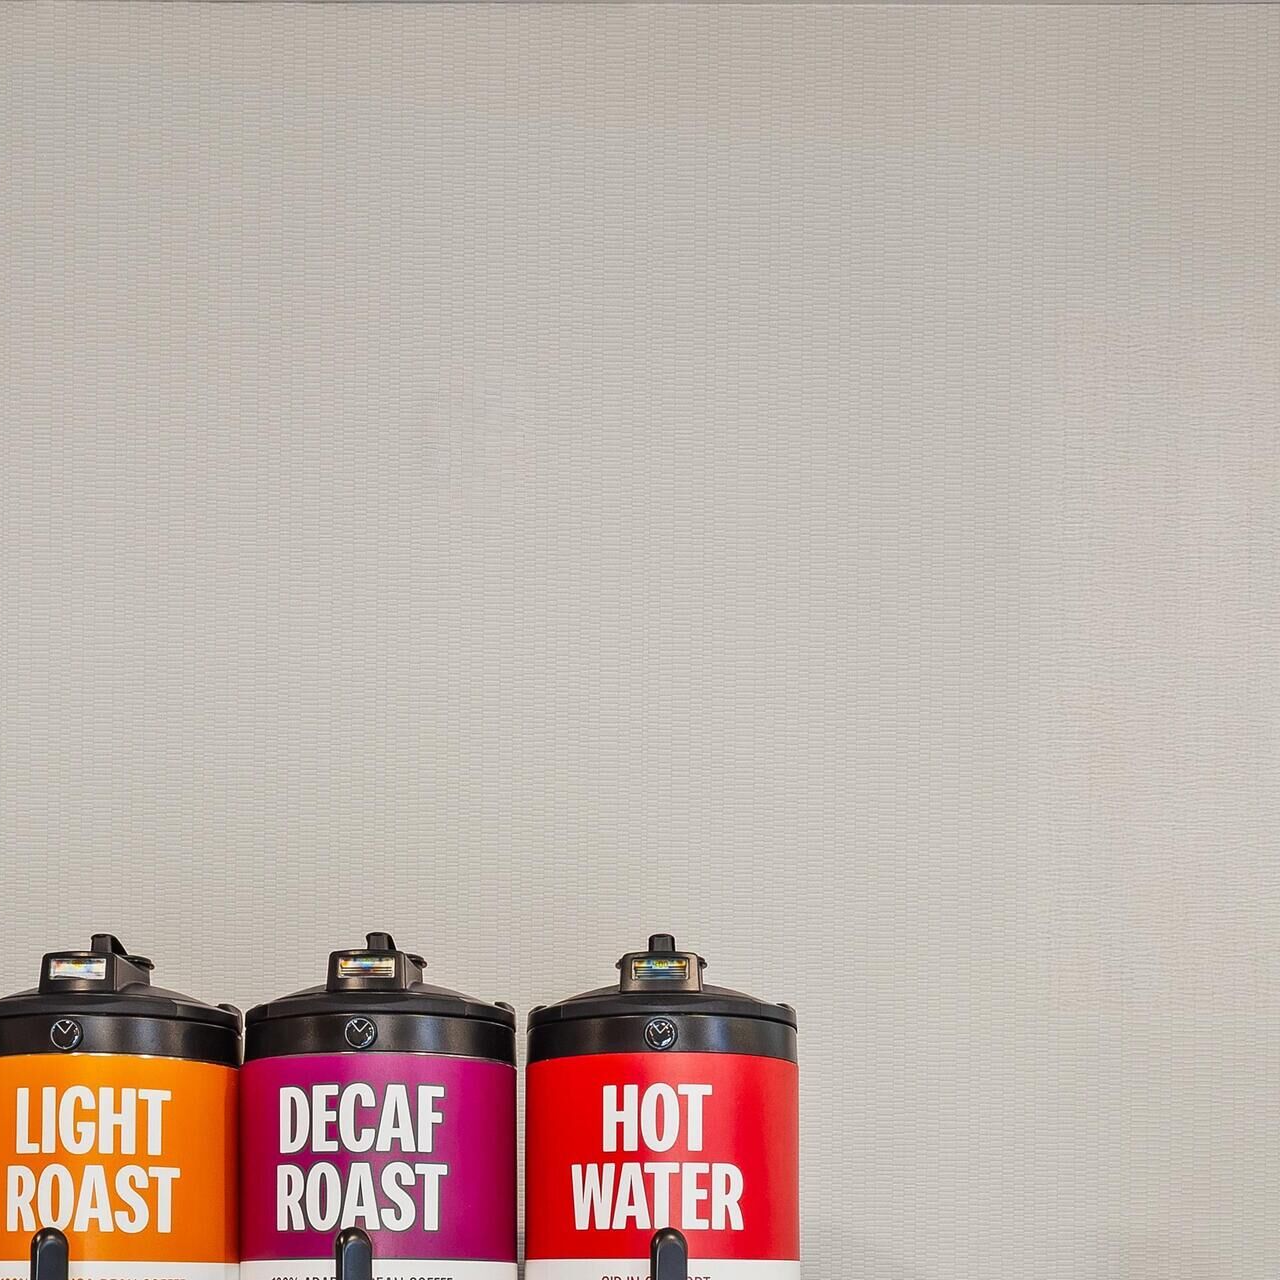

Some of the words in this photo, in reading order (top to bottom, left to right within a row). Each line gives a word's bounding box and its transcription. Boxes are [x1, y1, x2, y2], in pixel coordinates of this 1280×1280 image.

[15, 1085, 172, 1156] LIGHT
[279, 1082, 445, 1154] DECAF
[602, 1082, 713, 1152] HOT
[6, 1163, 181, 1233] ROAST
[276, 1161, 448, 1232] ROAST
[571, 1162, 744, 1231] WATER
